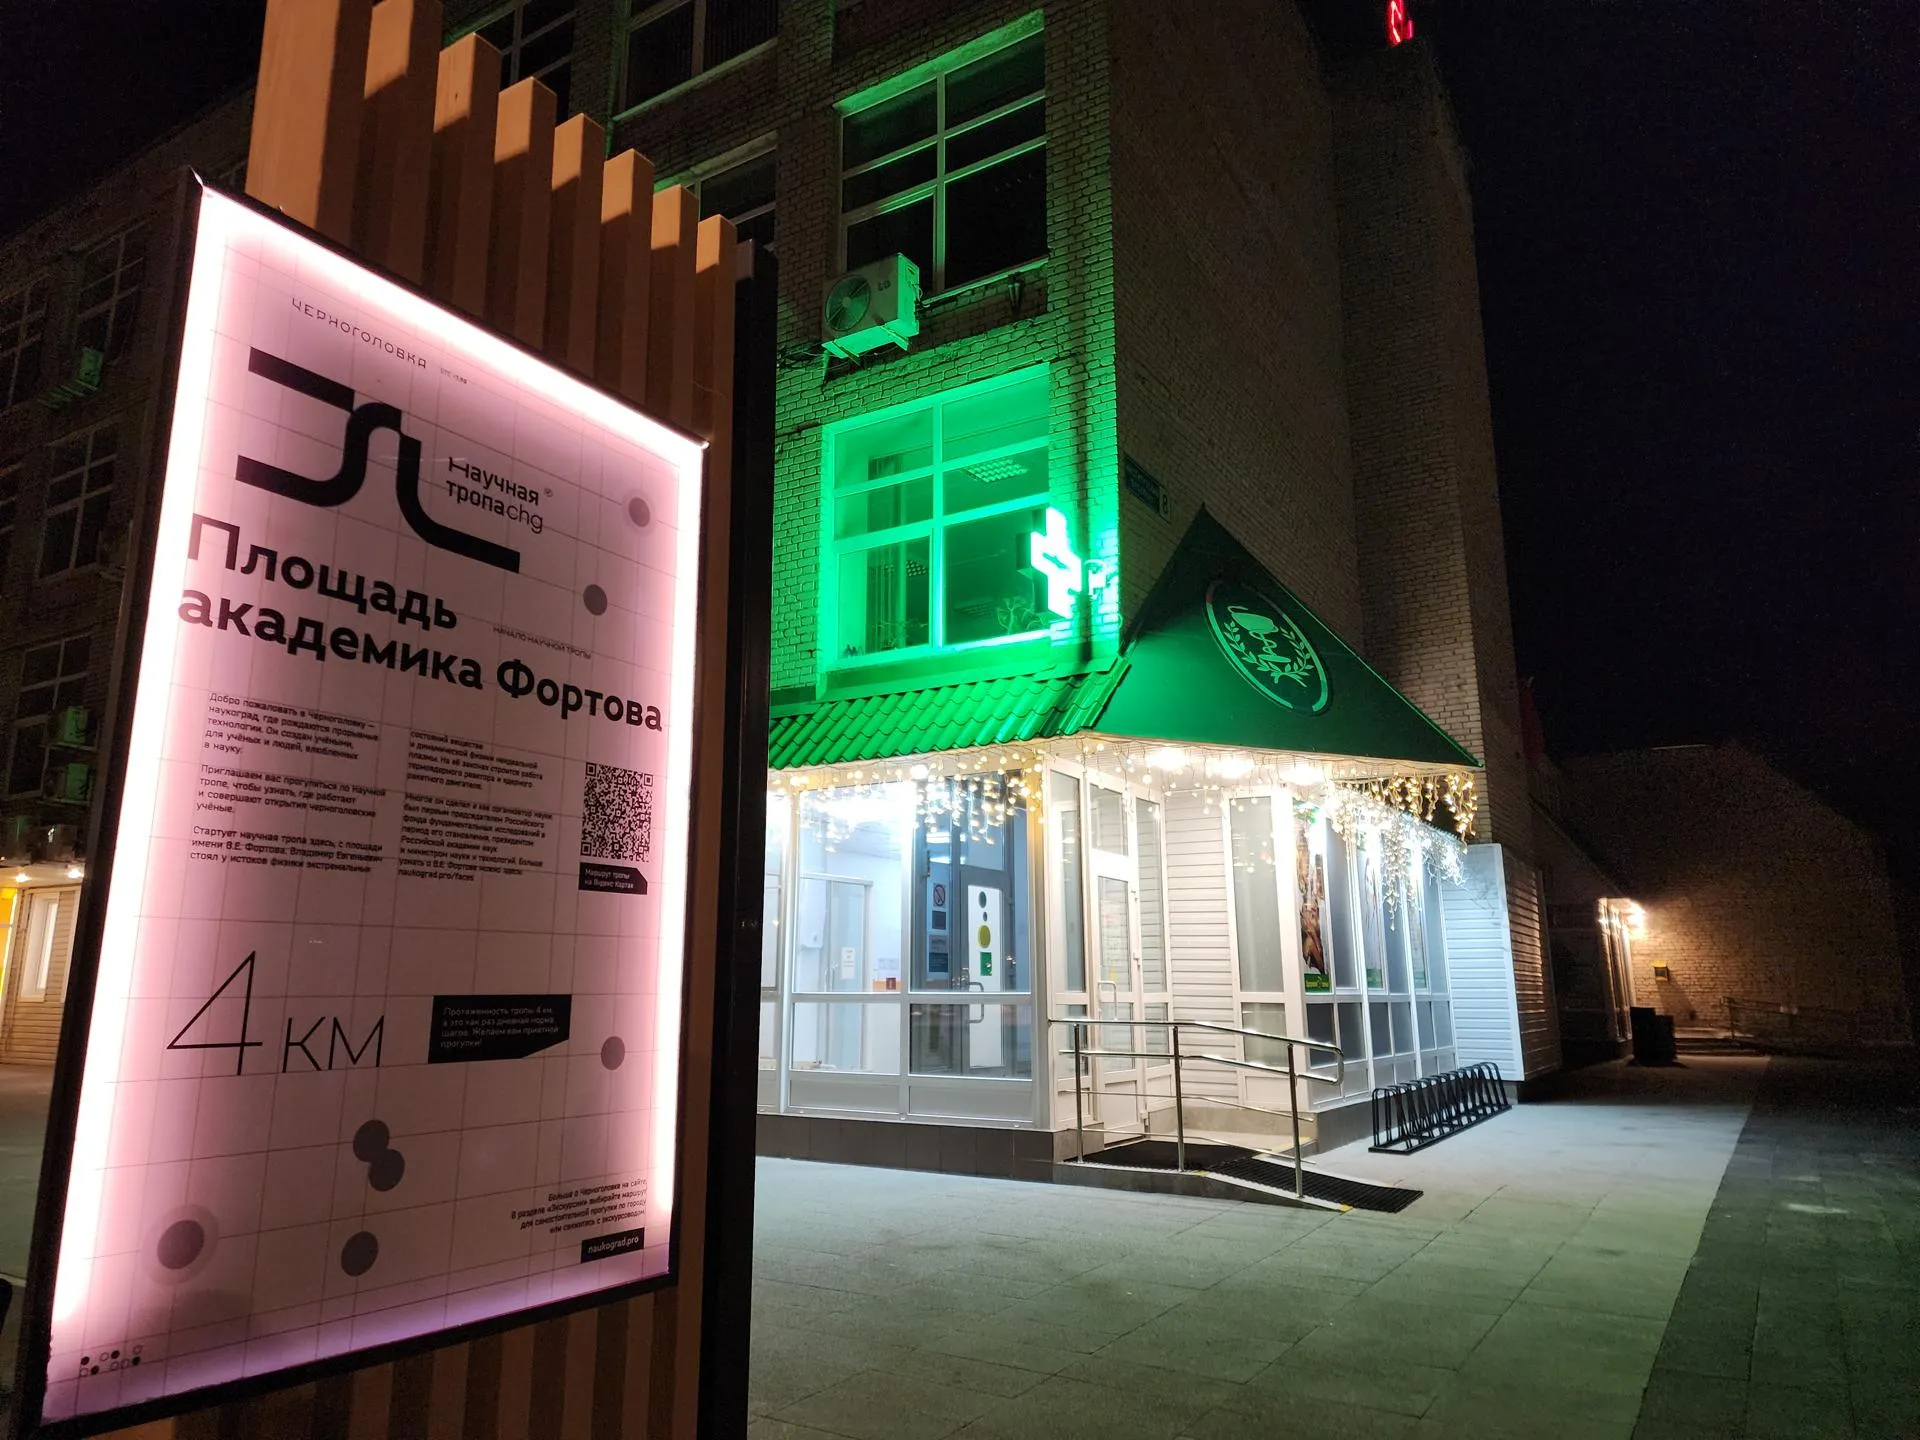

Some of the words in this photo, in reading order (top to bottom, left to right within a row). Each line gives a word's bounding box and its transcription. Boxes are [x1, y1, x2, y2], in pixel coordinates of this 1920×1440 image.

[292, 298, 427, 369] ЧЕРНОГОЛОВКА
[449, 456, 539, 506] Научная
[188, 513, 457, 631] Площадь
[493, 627, 526, 641] НАЧАЛО
[528, 637, 565, 652] НАУЧНОЙ
[566, 646, 591, 659] ТРОПЫ
[178, 589, 483, 690] академика
[497, 659, 662, 732] Фортова
[210, 692, 240, 705] Добро
[243, 700, 298, 716] пожаловать
[263, 715, 279, 724] где
[281, 719, 330, 733] рождаются
[266, 726, 279, 735] Он
[281, 730, 312, 740] создан
[205, 730, 223, 738] для
[227, 732, 261, 745] учёных
[410, 731, 448, 742] состояний
[201, 764, 262, 780] Приглашаем
[265, 774, 281, 783] вас
[491, 766, 520, 777] строится
[207, 791, 262, 804] совершают
[264, 798, 308, 809] открытия
[232, 782, 261, 793] чтобы
[299, 790, 314, 799] где
[316, 793, 356, 804] работают
[505, 817, 544, 828] Российского
[193, 826, 238, 838] Стартует
[240, 831, 279, 841] научная
[281, 835, 307, 845] тропа
[346, 842, 383, 852] площади
[401, 835, 444, 846] Российской
[190, 852, 218, 860] стоял
[221, 854, 227, 863] у
[230, 855, 268, 865] истоков
[270, 857, 303, 868] физики
[192, 840, 223, 849] имени
[290, 847, 334, 859] Владимир
[336, 851, 383, 862] Евгеньевич
[585, 869, 611, 879] Маршрут
[166, 951, 263, 1076] 4
[472, 1028, 506, 1036] Желаем
[481, 1019, 495, 1028] раз
[622, 1182, 629, 1190] на
[520, 1221, 533, 1230] для
[618, 1202, 626, 1210] по
[588, 1235, 640, 1254] naukograd.pro
